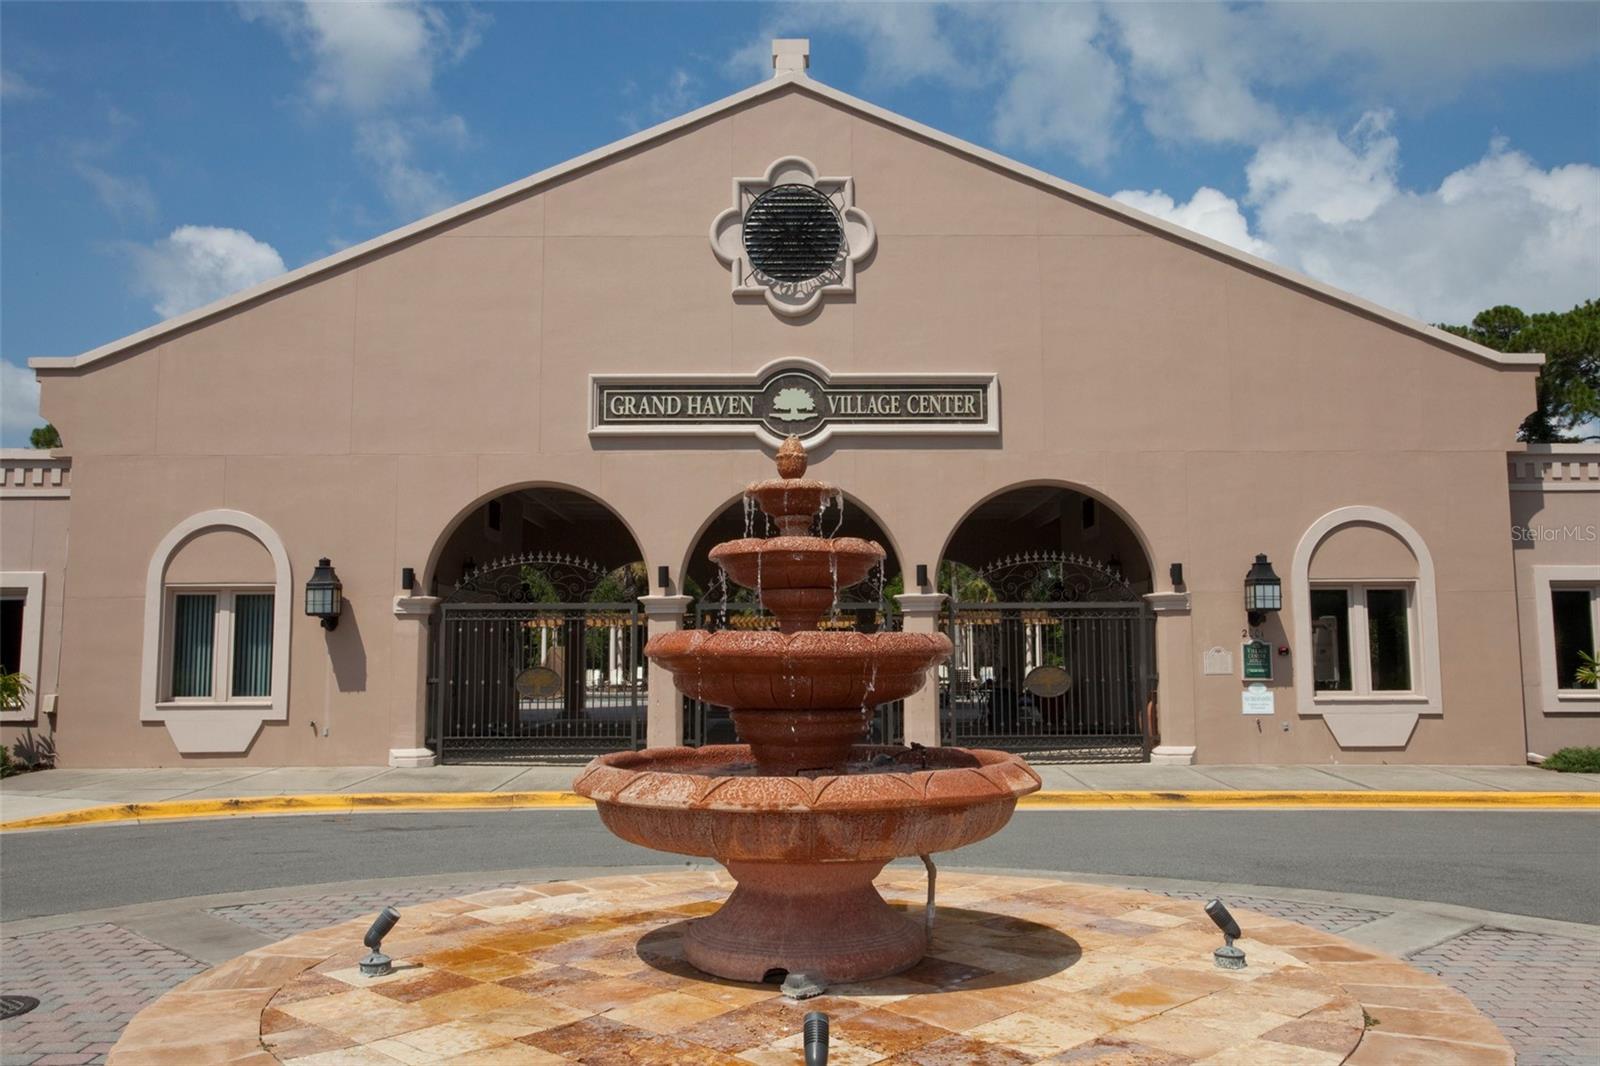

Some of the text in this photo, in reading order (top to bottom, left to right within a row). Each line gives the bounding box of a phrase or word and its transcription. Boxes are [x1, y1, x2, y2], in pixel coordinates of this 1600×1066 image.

[610, 394, 976, 415] GRAND HAVEN VILLAGE CENTER
